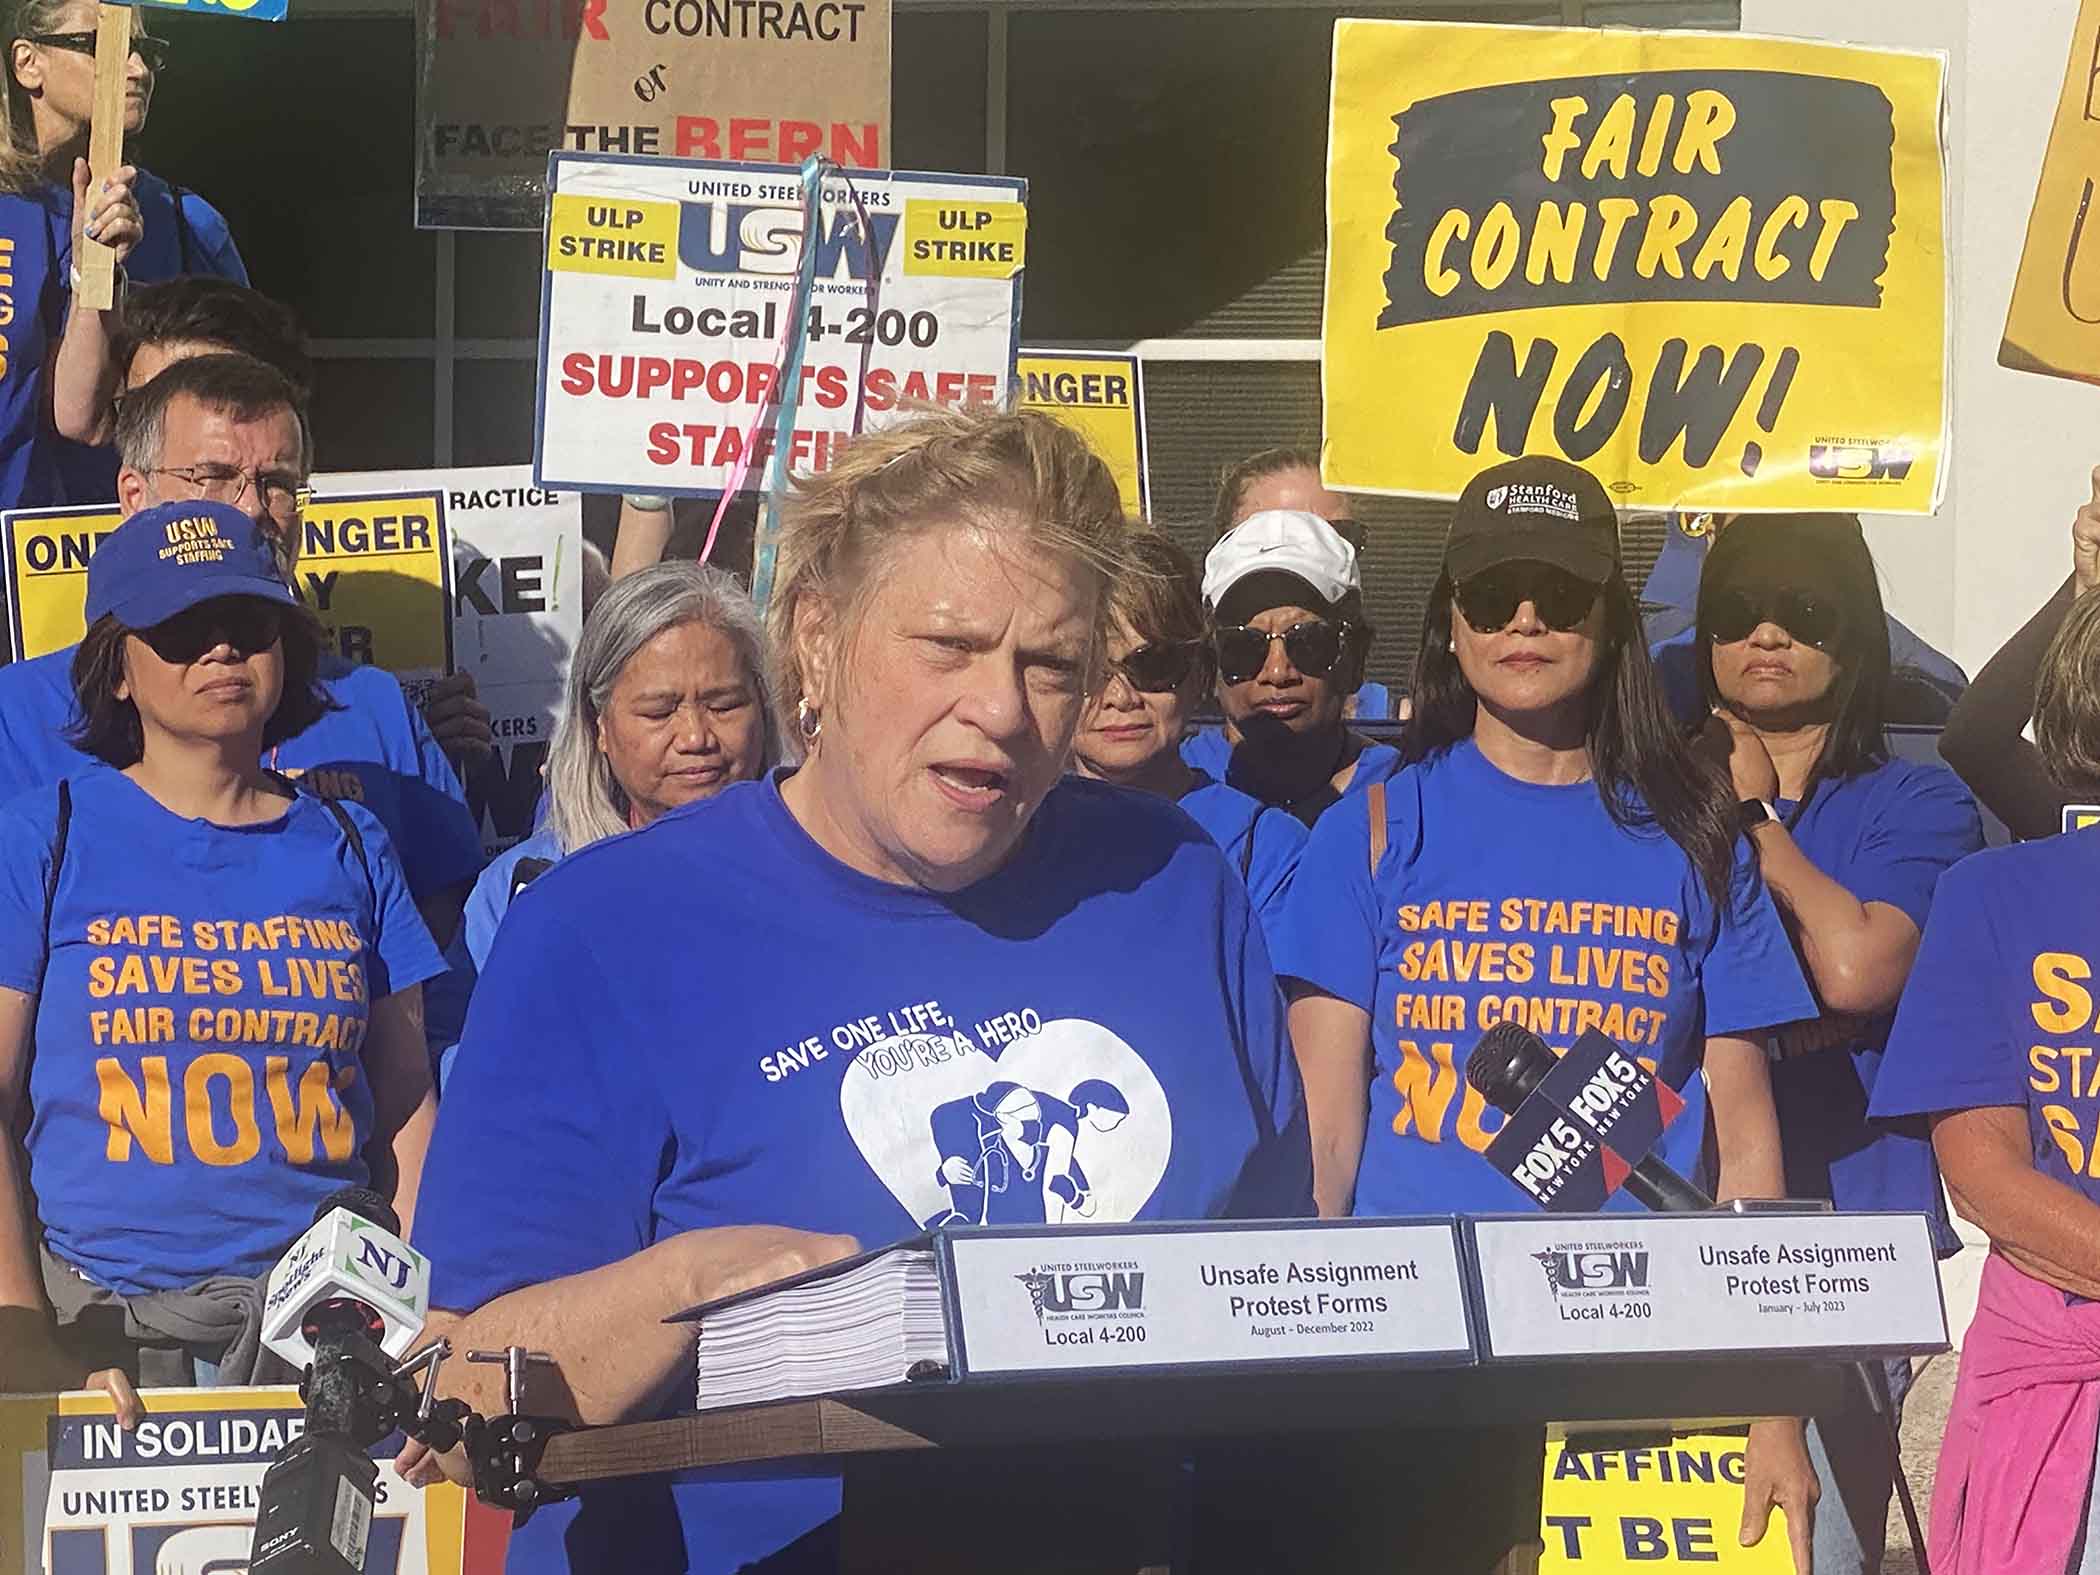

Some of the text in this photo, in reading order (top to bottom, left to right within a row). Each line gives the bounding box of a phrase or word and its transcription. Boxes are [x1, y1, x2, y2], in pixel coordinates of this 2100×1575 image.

[644, 0, 866, 41] CONTRACT
[633, 62, 667, 103] or
[434, 115, 880, 168] FACE THE BERN
[1541, 88, 1737, 182] FAIR
[688, 181, 751, 198] UNITED
[587, 206, 644, 229] ULP
[938, 210, 993, 231] ULP
[559, 236, 666, 264] STRIKE
[678, 200, 900, 280] USW
[913, 239, 1014, 263] STRIKE
[1422, 193, 1860, 298] CONTRACT
[695, 277, 726, 289] UNITY
[729, 279, 749, 290] AND
[631, 295, 777, 339] Local
[561, 352, 996, 412] SUPPORTS SAFE
[1452, 329, 1801, 478] NOW!
[1814, 437, 1846, 445] UNITED
[1808, 445, 1914, 480] USW
[1508, 496, 1551, 506] HEALTH
[1509, 484, 1577, 504] Stanford
[166, 516, 218, 544] USW
[158, 538, 211, 560] SUPPORTS
[175, 548, 224, 566] STAFFING
[87, 915, 363, 953] SAFE STAFFING
[1397, 898, 1680, 946] SAFE STAFFING
[88, 955, 367, 1002] SAVES LIVES
[1397, 938, 1671, 998] SAVES LIVES
[90, 1007, 176, 1046] FAIR
[1395, 994, 1667, 1045] FAIR CONTRACT
[759, 1000, 955, 1083] SAVE ONE LIFE,
[856, 1007, 1043, 1081] YOU'RE A HERO
[95, 1053, 357, 1167] NOW
[1595, 1074, 1651, 1136] NEW YORK
[1539, 1140, 1595, 1204] NEW YORK
[357, 1235, 411, 1289] NJ
[1554, 1240, 1644, 1251] UNITED STEELWORKERS
[1698, 1242, 1898, 1268] Unsafe Assignment
[1041, 1261, 1139, 1273] UNITED STEELWORKERS
[1199, 1259, 1419, 1287] Unsafe Assignment
[1557, 1252, 1649, 1288] USW
[1725, 1272, 1870, 1296] Protest Forms
[1042, 1272, 1145, 1312] USW
[1230, 1293, 1389, 1317] Protest Forms
[1758, 1302, 1794, 1316] January
[1803, 1302, 1822, 1315] July
[1822, 1301, 1846, 1313] 2023
[1559, 1302, 1652, 1321] Local 4-200
[1045, 1326, 1147, 1345] Local 4-200
[1250, 1324, 1286, 1338] August
[1296, 1322, 1348, 1335] December
[1348, 1321, 1374, 1334] 2022
[82, 1423, 123, 1460] IN
[63, 1488, 170, 1516] UNITED
[260, 1526, 299, 1553] SONY
[1619, 1516, 1719, 1562] BE
